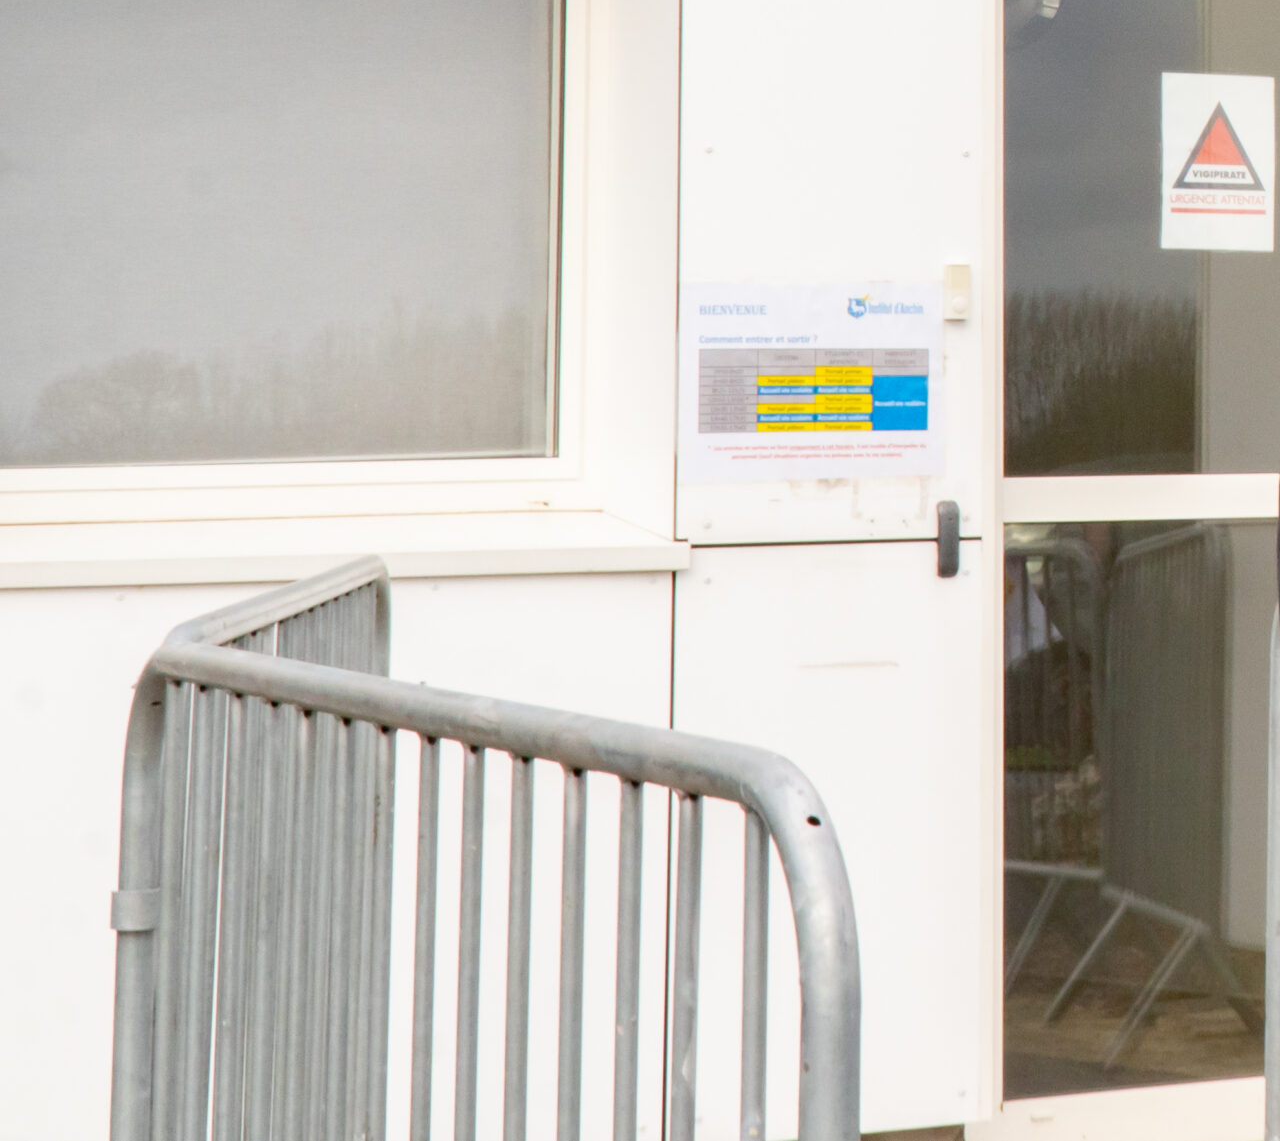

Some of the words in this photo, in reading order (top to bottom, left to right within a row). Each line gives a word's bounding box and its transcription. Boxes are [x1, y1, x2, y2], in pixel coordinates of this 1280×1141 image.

[1192, 170, 1247, 180] VIGIPIRATE
[1169, 194, 1217, 205] URGENCE
[1220, 195, 1266, 206] ATTENTAT
[699, 304, 768, 316] BIENVENUE
[699, 335, 744, 344] Comment
[745, 336, 774, 344] entrer
[775, 336, 785, 344] et
[787, 335, 811, 344] sortir
